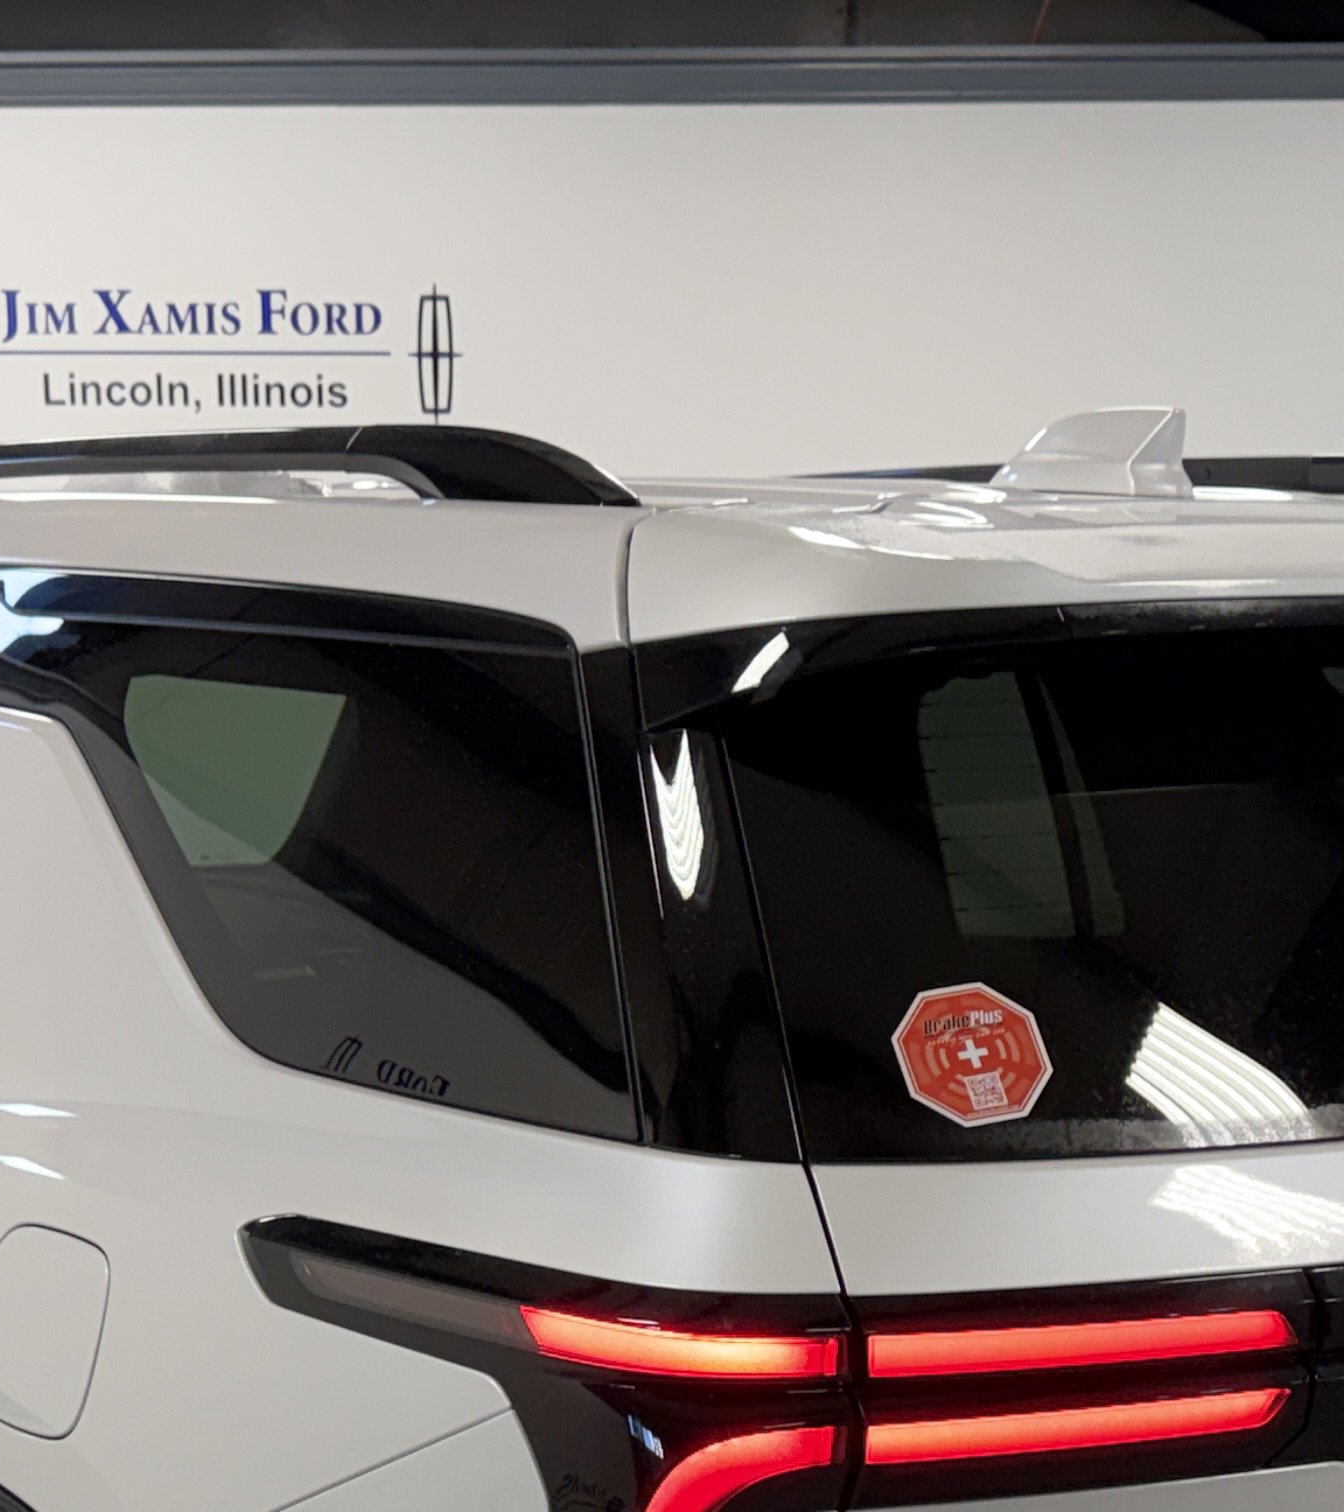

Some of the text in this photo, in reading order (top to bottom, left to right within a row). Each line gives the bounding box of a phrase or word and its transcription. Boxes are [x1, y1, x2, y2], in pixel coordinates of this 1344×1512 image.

[1, 289, 382, 343] JIM XAMIS FORD
[43, 373, 349, 413] Lincoln, Illinois
